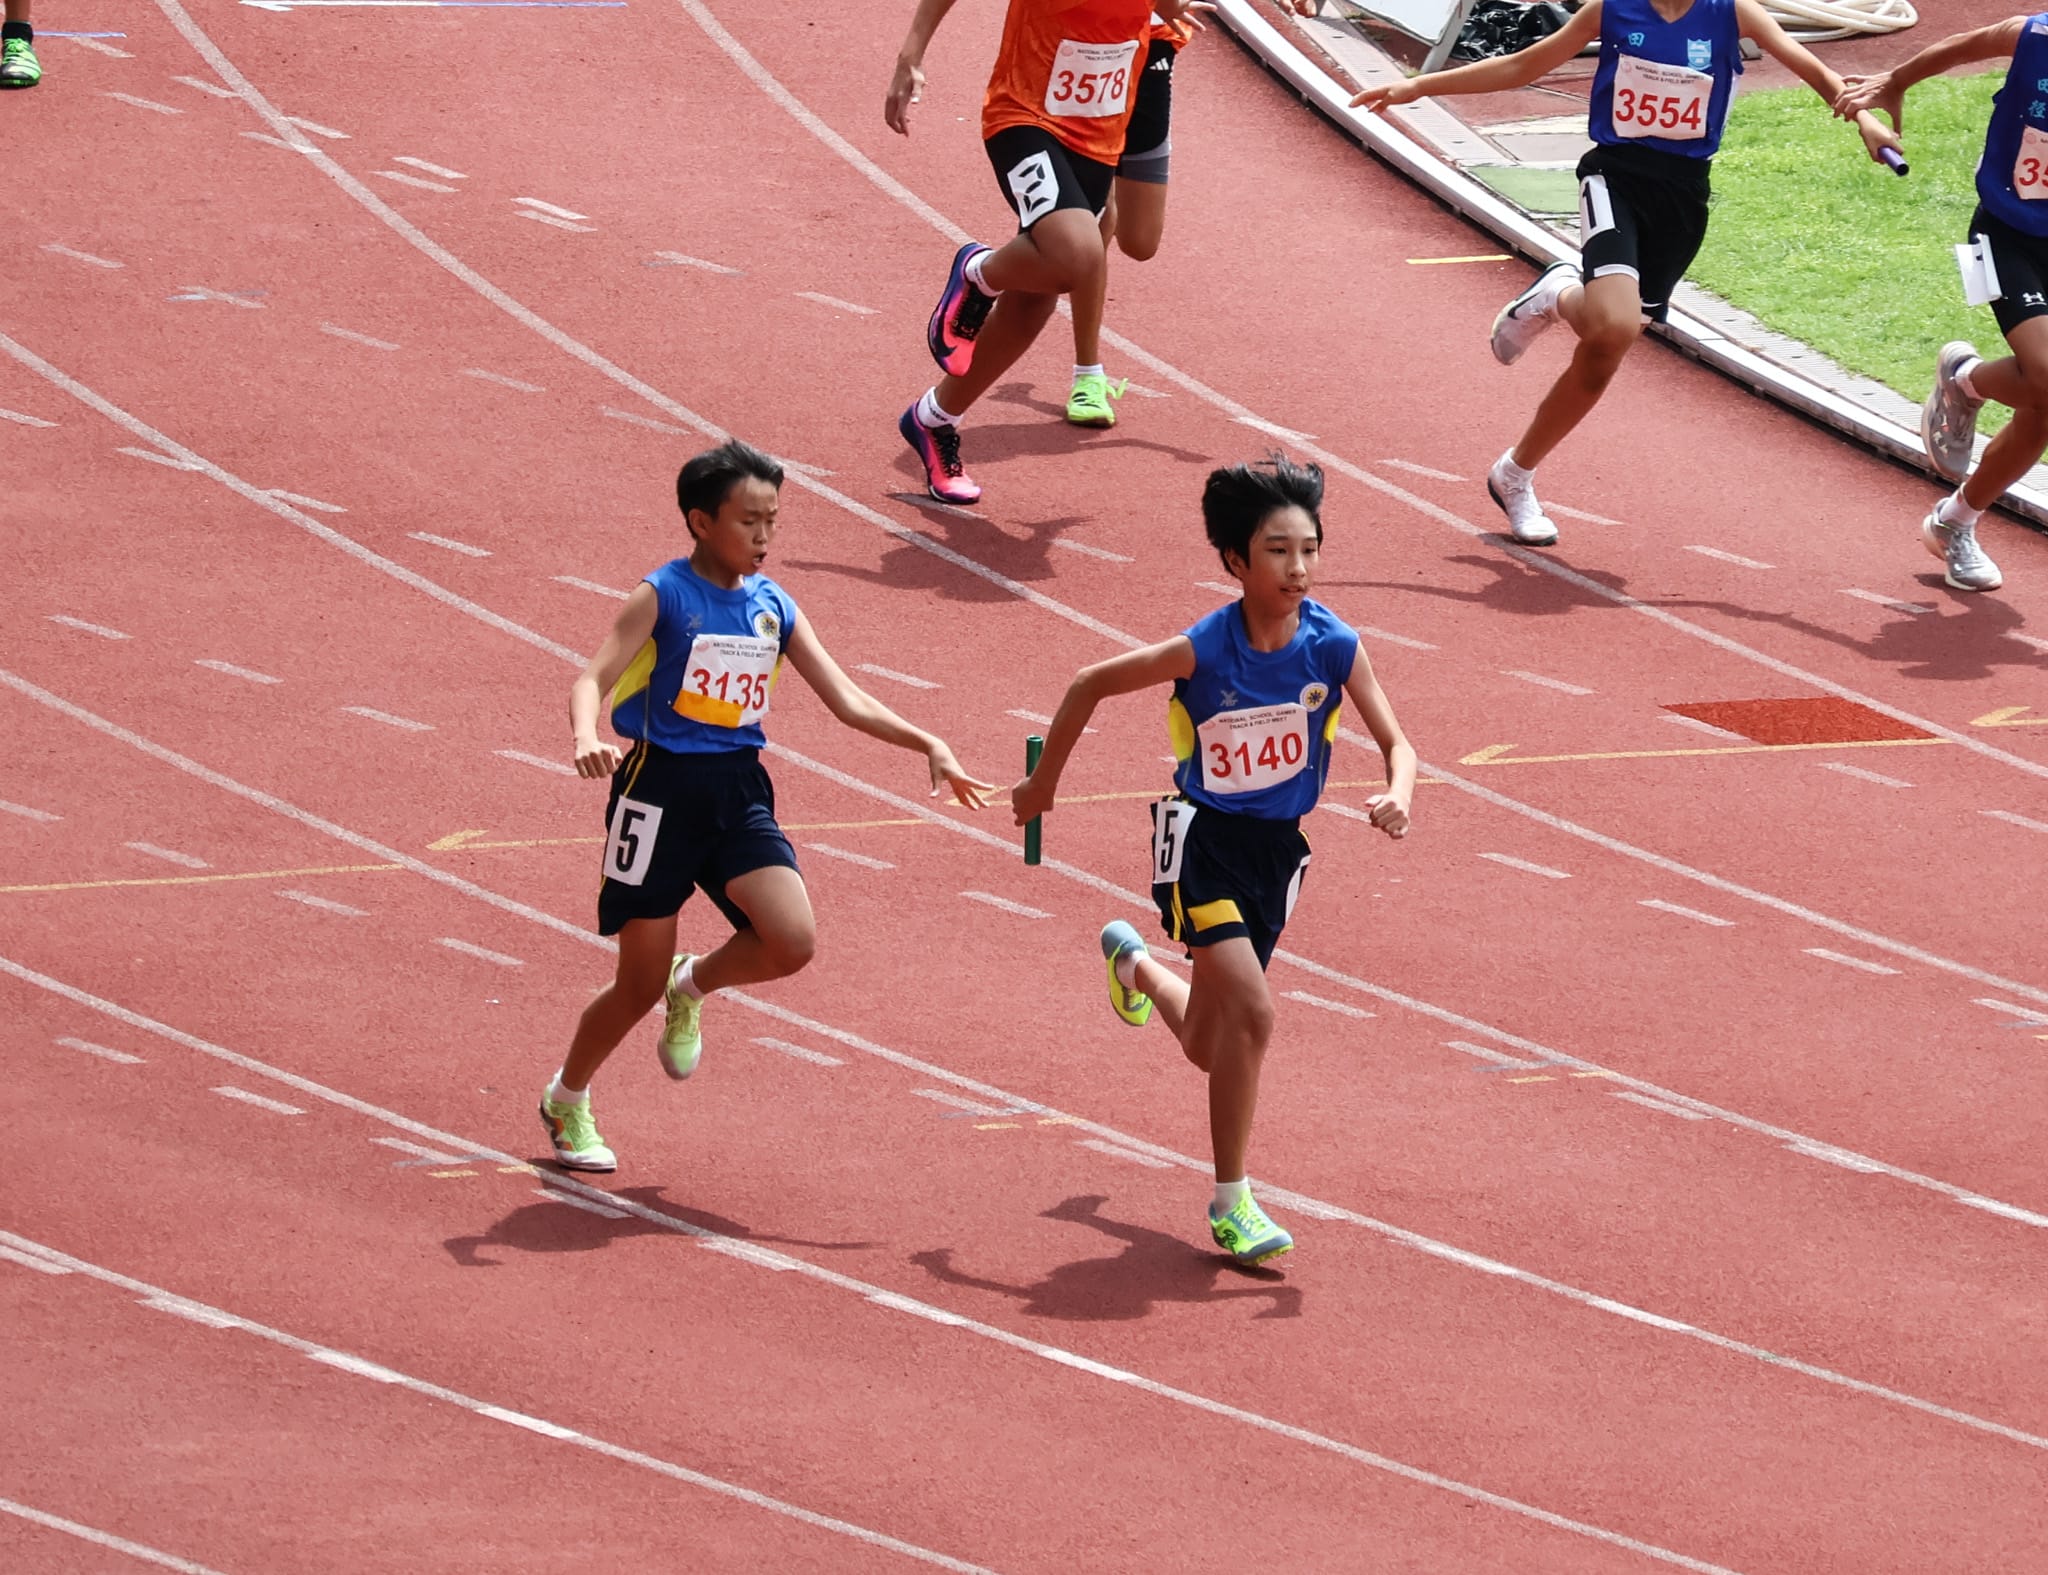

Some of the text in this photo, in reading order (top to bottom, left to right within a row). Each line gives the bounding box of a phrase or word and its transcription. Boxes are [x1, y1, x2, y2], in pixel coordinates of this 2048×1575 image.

[1053, 67, 1126, 104] 3578
[1615, 88, 1701, 130] 3554
[1018, 163, 1052, 212] 2
[1582, 181, 1597, 229] 1
[692, 669, 769, 711] 3135
[1229, 722, 1249, 730] TRACK
[1249, 711, 1273, 720] SCHOOL
[1209, 732, 1303, 778] 3140
[615, 808, 646, 872] 5
[1160, 810, 1179, 874] 5
